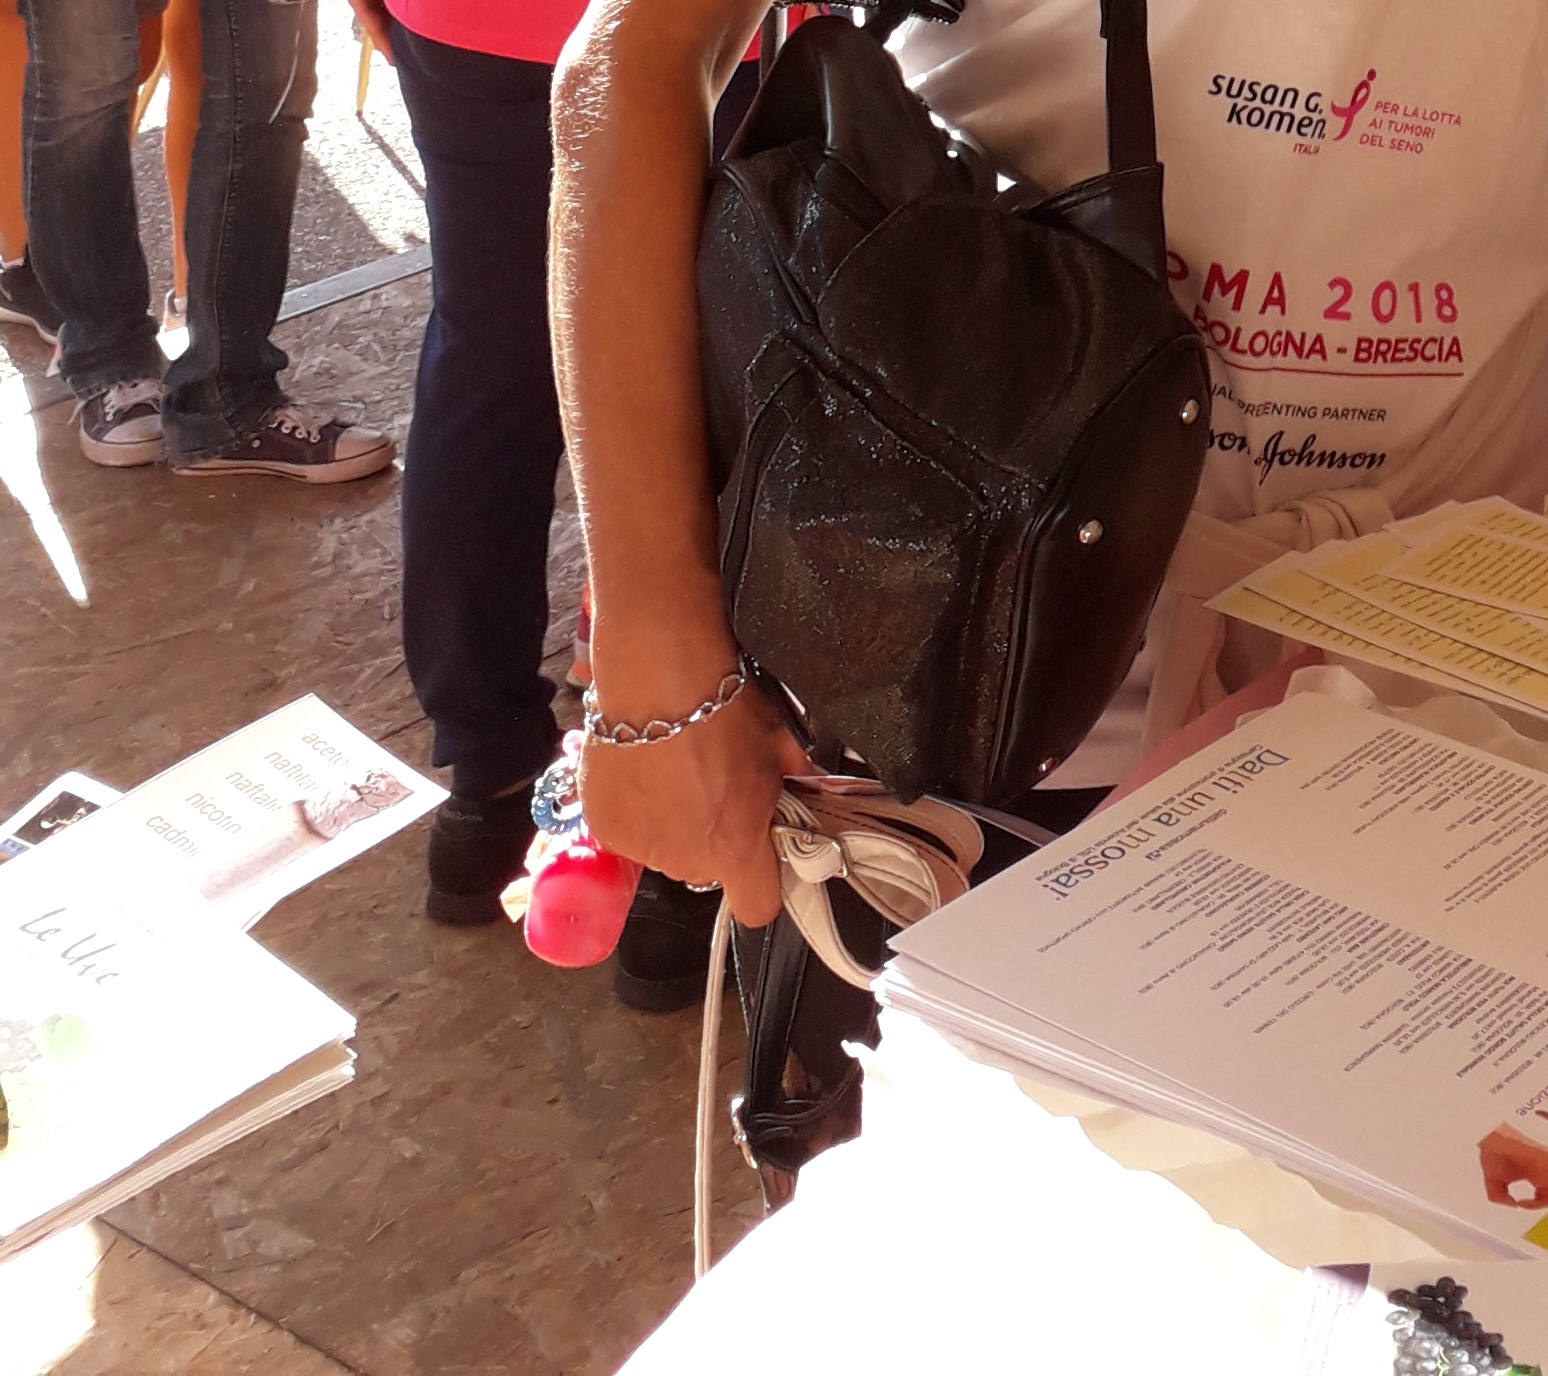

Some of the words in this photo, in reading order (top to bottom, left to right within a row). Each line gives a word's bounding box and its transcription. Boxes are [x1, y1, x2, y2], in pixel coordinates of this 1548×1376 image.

[1208, 73, 1300, 110] susan
[1368, 117, 1382, 130] AI
[1387, 119, 1437, 140] TUMORI
[1375, 100, 1400, 114] PER
[1403, 105, 1420, 118] LA
[1422, 107, 1462, 127] LOTTA
[1359, 132, 1385, 147] DEL
[1388, 137, 1424, 155] SENO
[1322, 275, 1460, 325] 2018
[1353, 335, 1464, 364] BRESCIA
[1321, 406, 1387, 423] PARTNER
[1209, 745, 1292, 797] Datti
[1153, 785, 1206, 834] una
[1039, 817, 1159, 902] mossa!
